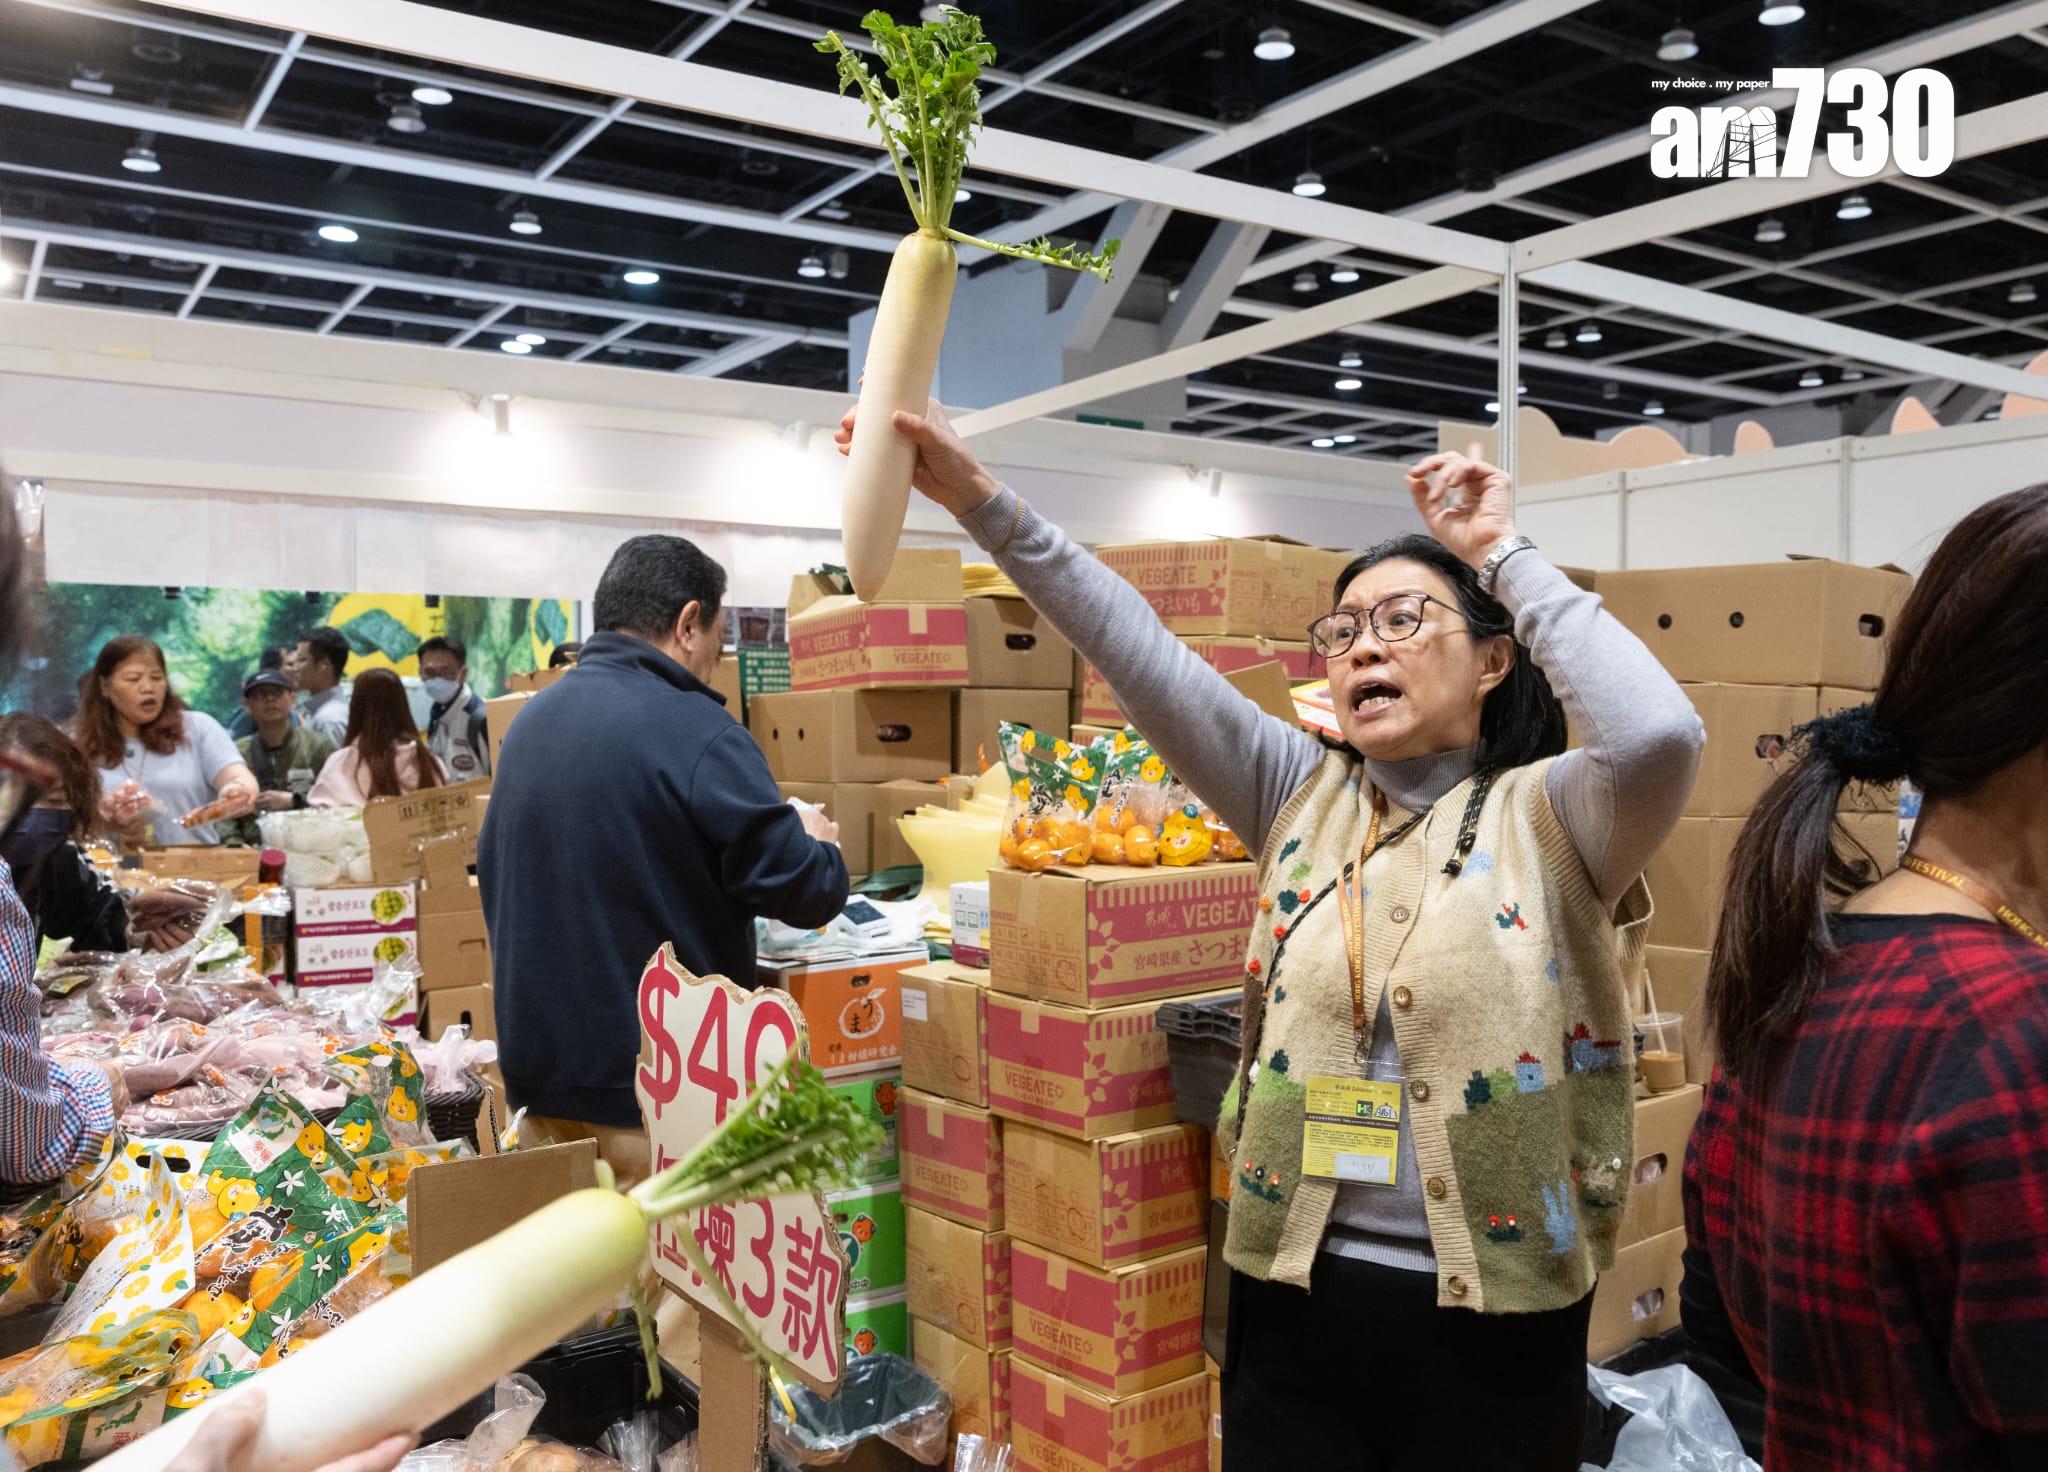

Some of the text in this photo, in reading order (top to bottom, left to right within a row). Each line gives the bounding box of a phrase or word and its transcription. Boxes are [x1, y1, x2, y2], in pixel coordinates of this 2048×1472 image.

[1137, 566, 1197, 585] VEGEATE
[814, 630, 849, 653] VEGEATE
[1911, 859, 1965, 889] FESTIVAL
[1181, 897, 1259, 931] VEGEAT
[1354, 955, 1362, 979] KONG
[1029, 1317, 1083, 1351] VEGEATE
